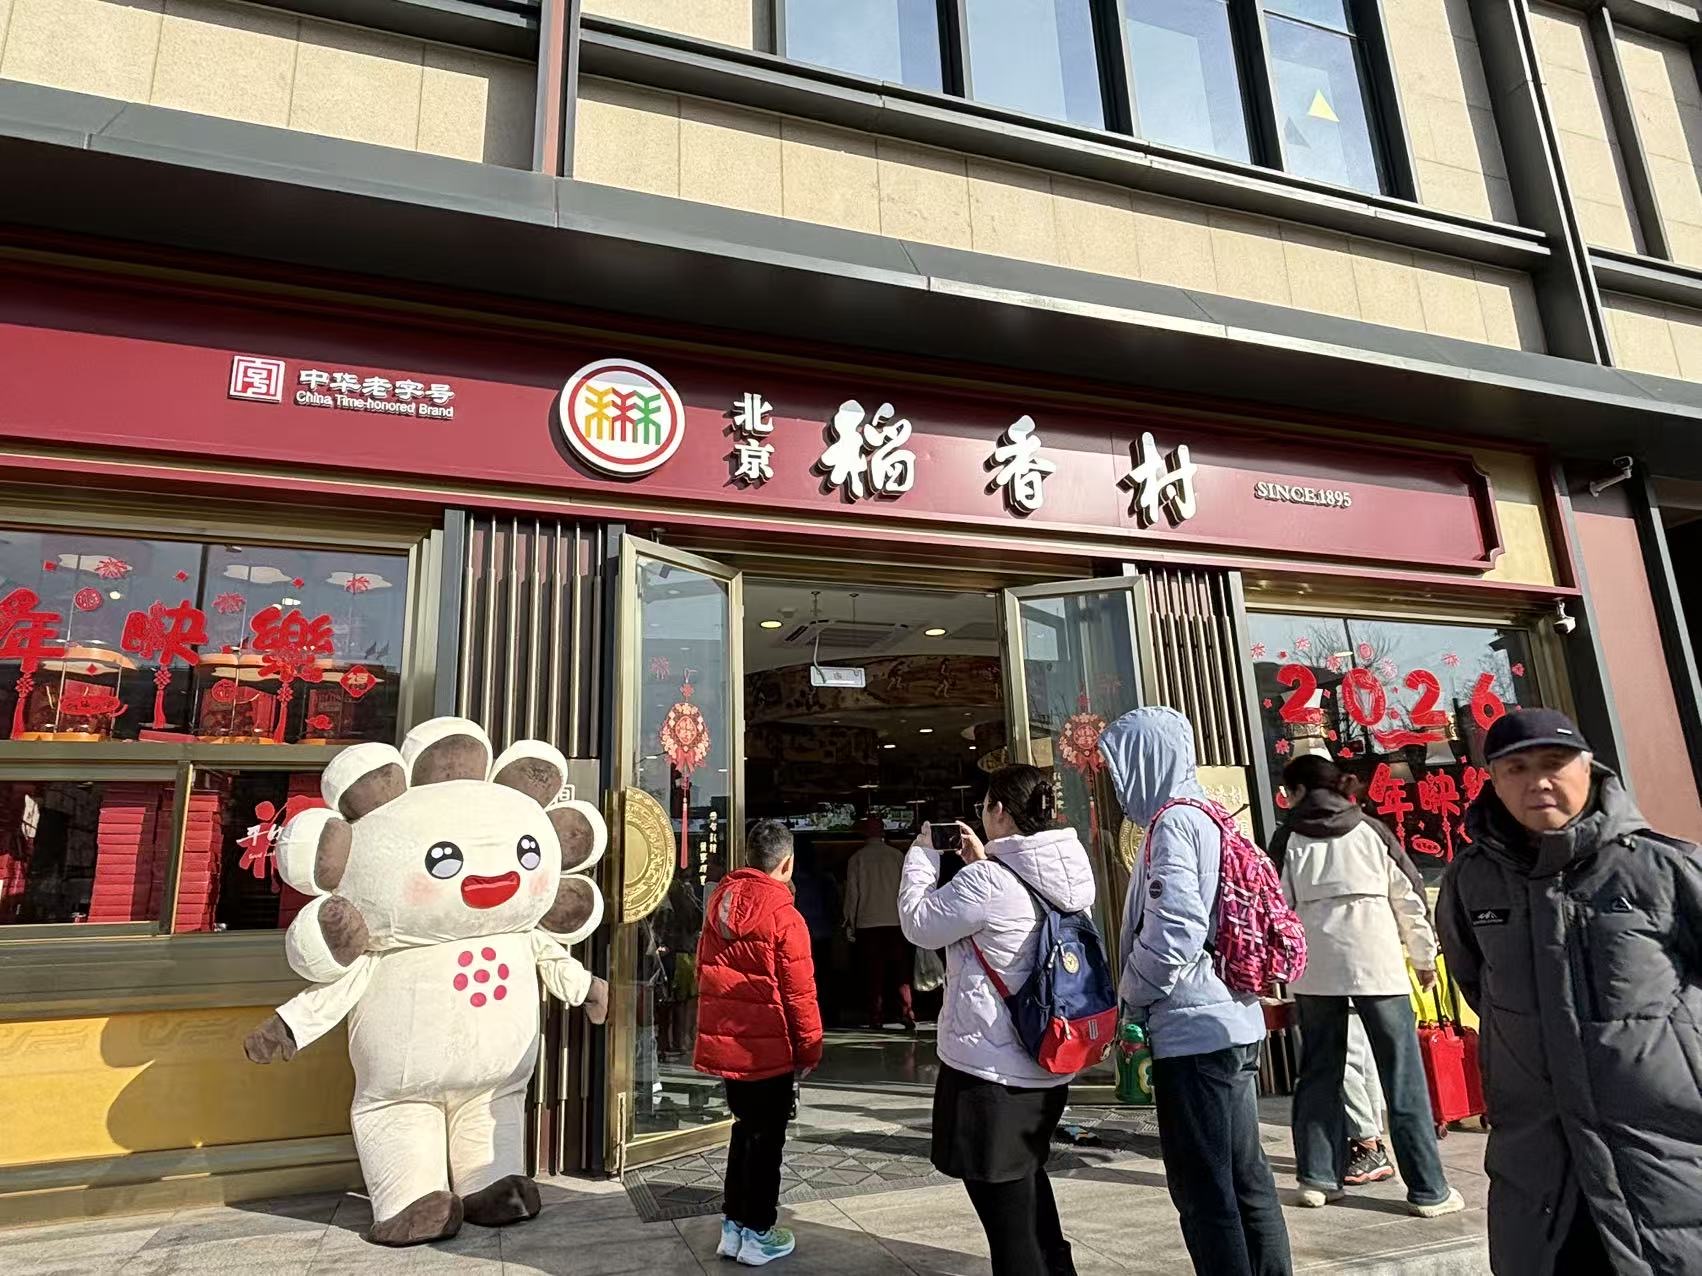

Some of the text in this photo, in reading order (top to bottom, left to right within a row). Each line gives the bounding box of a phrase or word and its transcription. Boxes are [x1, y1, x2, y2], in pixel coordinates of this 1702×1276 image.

[296, 390, 454, 418] China Time-honored Brand
[299, 368, 455, 404] 中华老字号
[733, 392, 775, 480] 北京
[820, 399, 1198, 523] 稻香村
[1276, 663, 1506, 732] 2026
